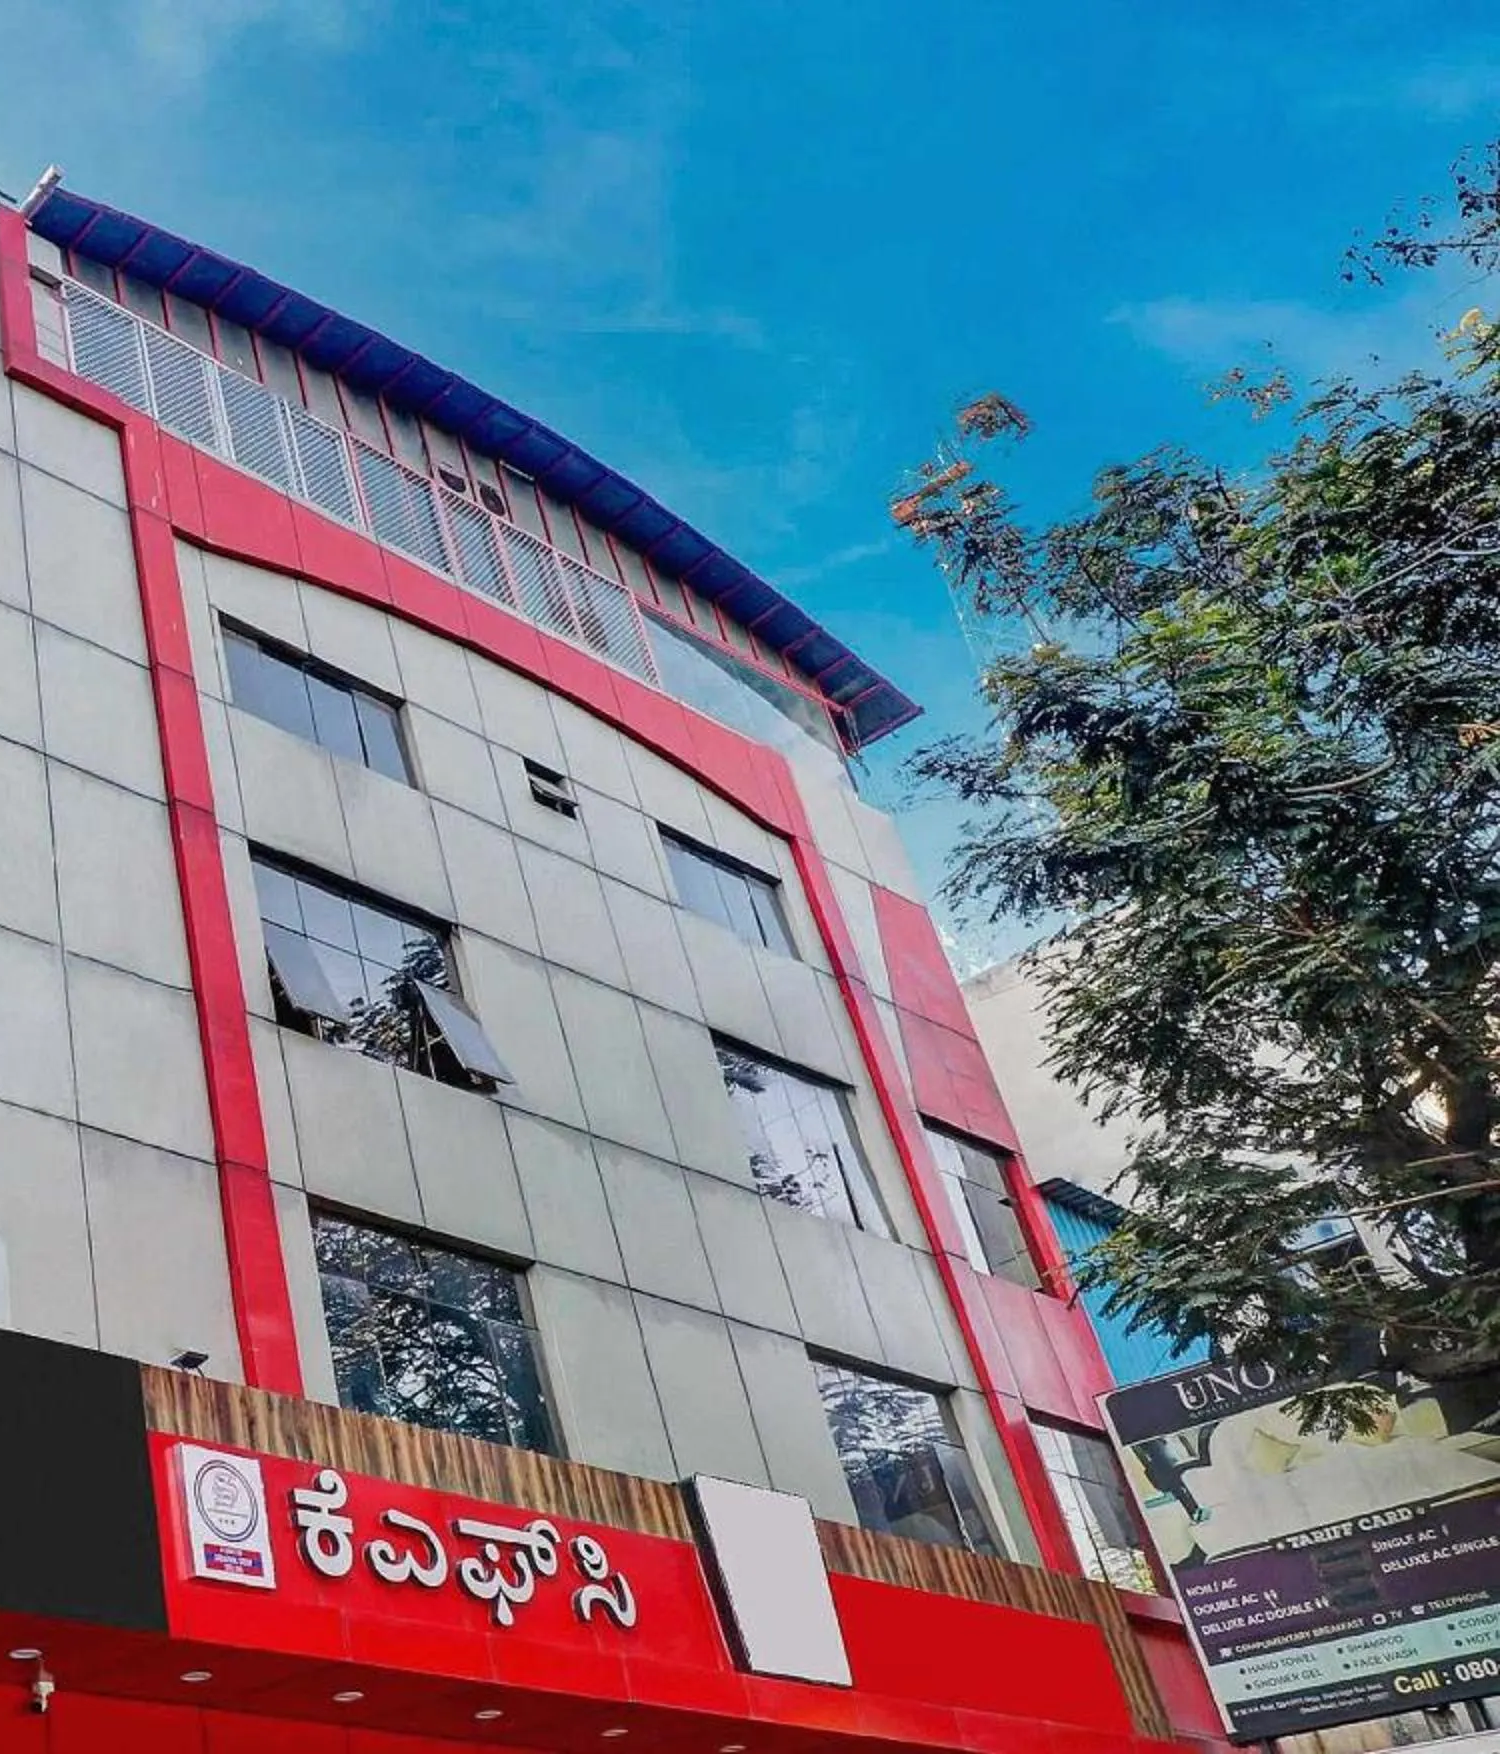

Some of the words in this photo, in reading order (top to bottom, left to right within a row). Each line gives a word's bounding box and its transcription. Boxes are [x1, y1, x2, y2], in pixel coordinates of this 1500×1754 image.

[1172, 1359, 1275, 1410] UNO
[1286, 1521, 1353, 1549] TARIFF
[1358, 1507, 1414, 1531] CARD
[1371, 1533, 1414, 1553] SINGLE
[1418, 1529, 1437, 1542] AC
[1381, 1552, 1431, 1573] DELUXE
[1432, 1547, 1452, 1560] AC
[1451, 1536, 1500, 1555] SINGLE
[1221, 1578, 1238, 1590] AC
[1193, 1597, 1240, 1616] DOUBLE
[1241, 1593, 1259, 1606] AC
[1201, 1617, 1246, 1635] DELUXE
[1247, 1613, 1265, 1626] AC
[1265, 1601, 1314, 1621] DOUBLE
[1394, 1670, 1441, 1694] Call
